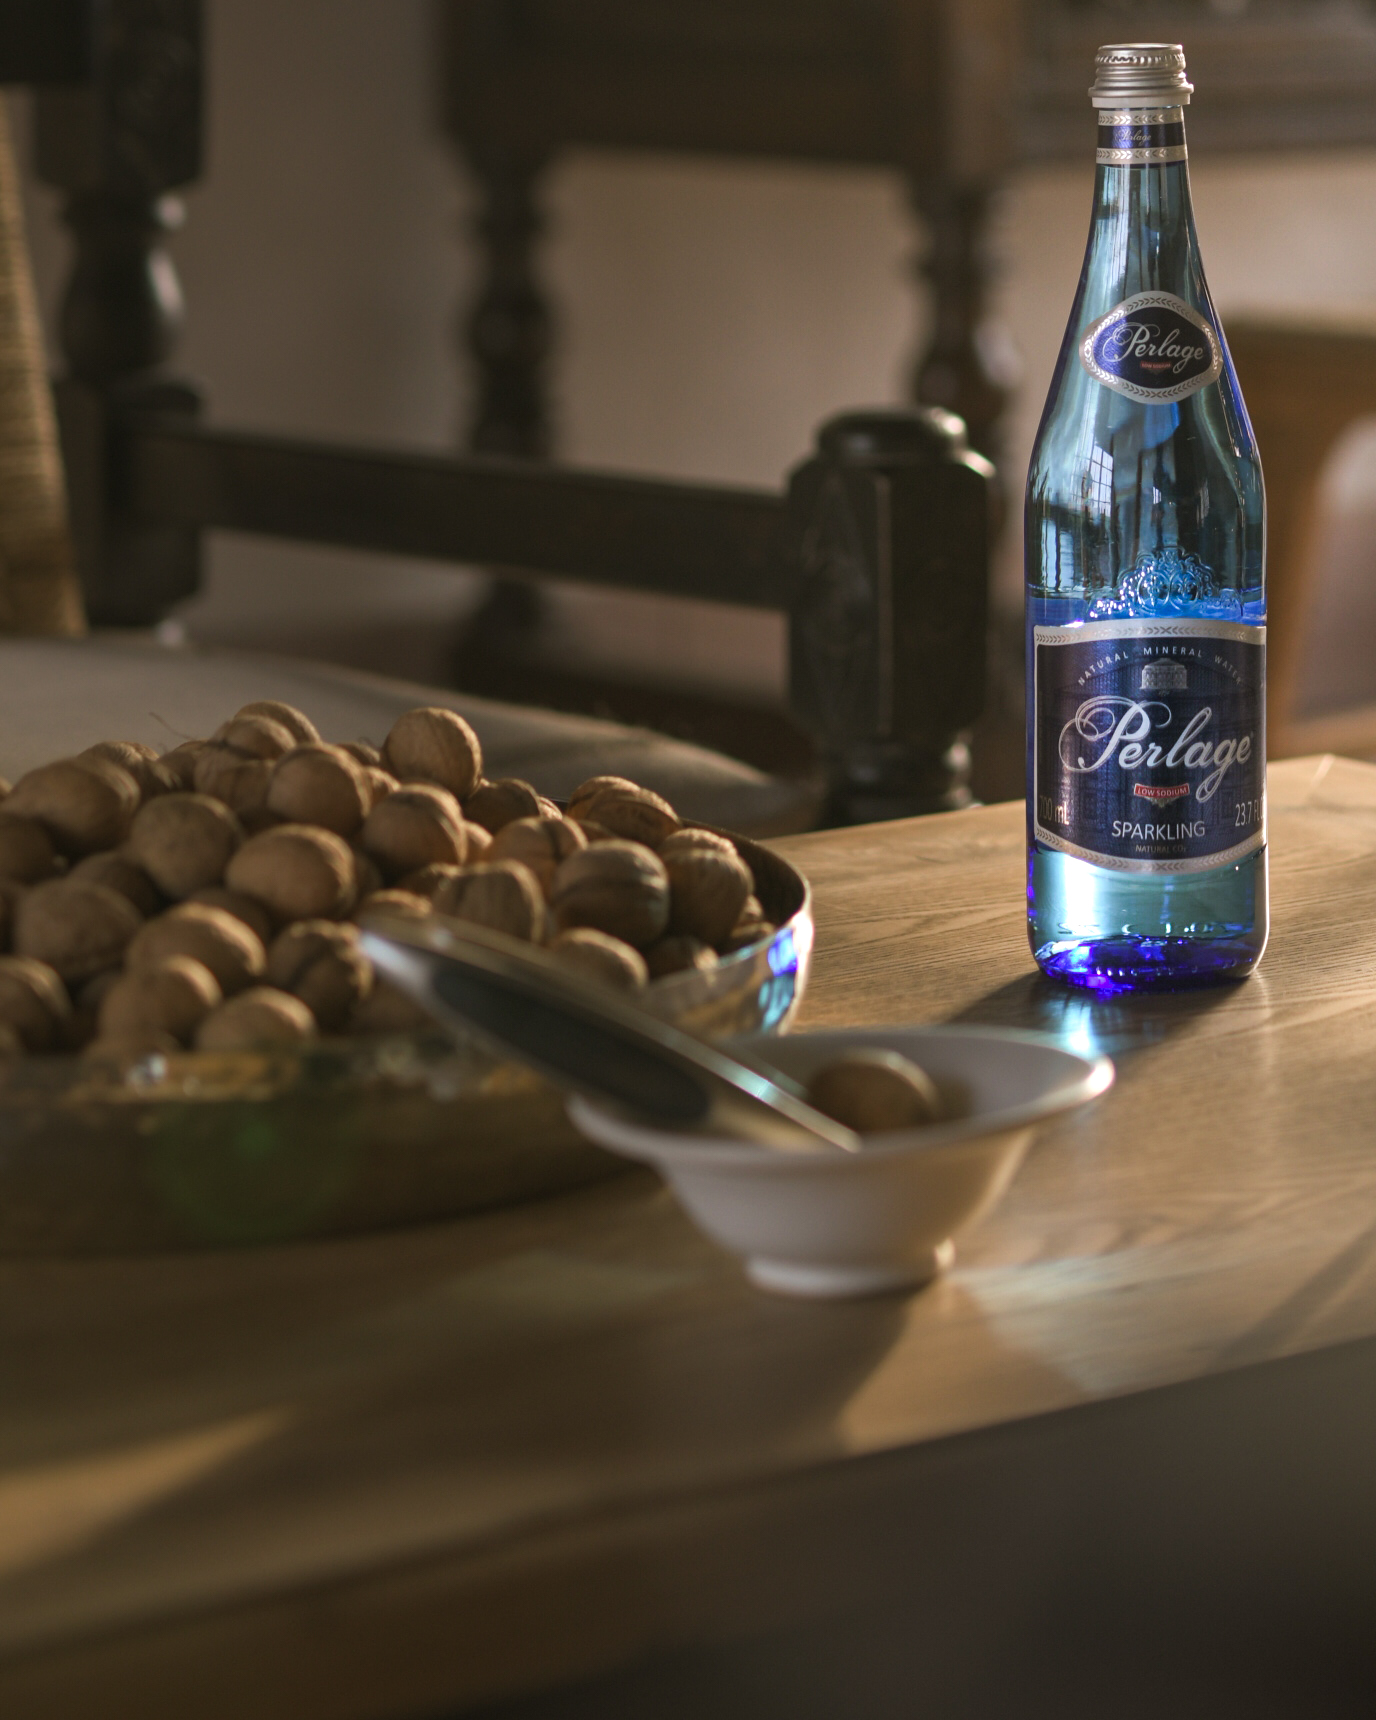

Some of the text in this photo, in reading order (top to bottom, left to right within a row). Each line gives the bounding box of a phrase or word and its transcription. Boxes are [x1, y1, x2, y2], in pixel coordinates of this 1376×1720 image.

[1102, 321, 1204, 374] Perlage
[1077, 646, 1242, 686] NATURAL MINERAL WATER
[1058, 695, 1252, 803] Perlage
[1138, 787, 1188, 797] LOW SODIUM
[1054, 801, 1070, 826] mL
[1234, 801, 1252, 827] 23.7
[1111, 820, 1206, 841] SPARKLING
[1135, 844, 1170, 854] NATURAL
